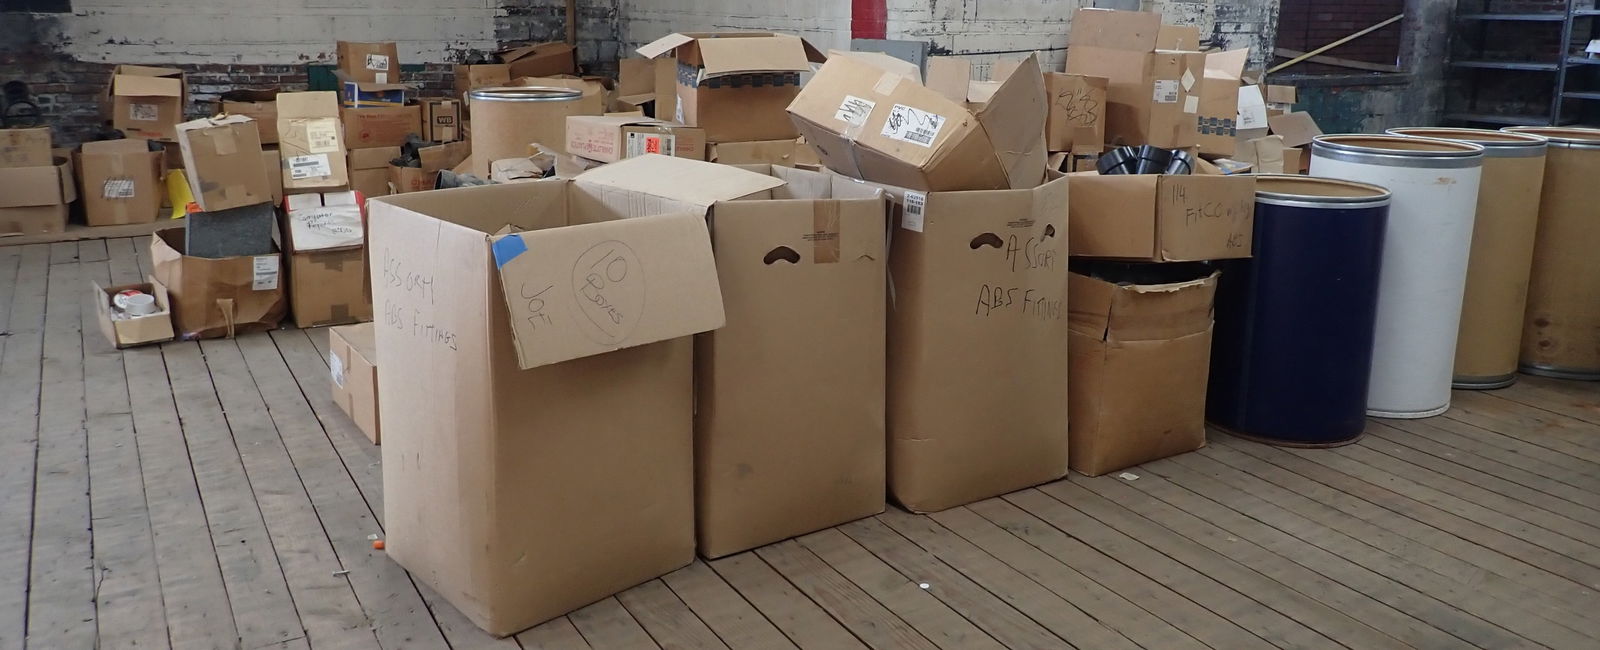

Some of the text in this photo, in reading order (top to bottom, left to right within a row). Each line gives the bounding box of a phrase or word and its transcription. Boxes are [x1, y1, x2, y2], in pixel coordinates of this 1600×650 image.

[590, 248, 628, 283] 10
[520, 281, 554, 331] JOE
[975, 283, 1019, 317] ABS
